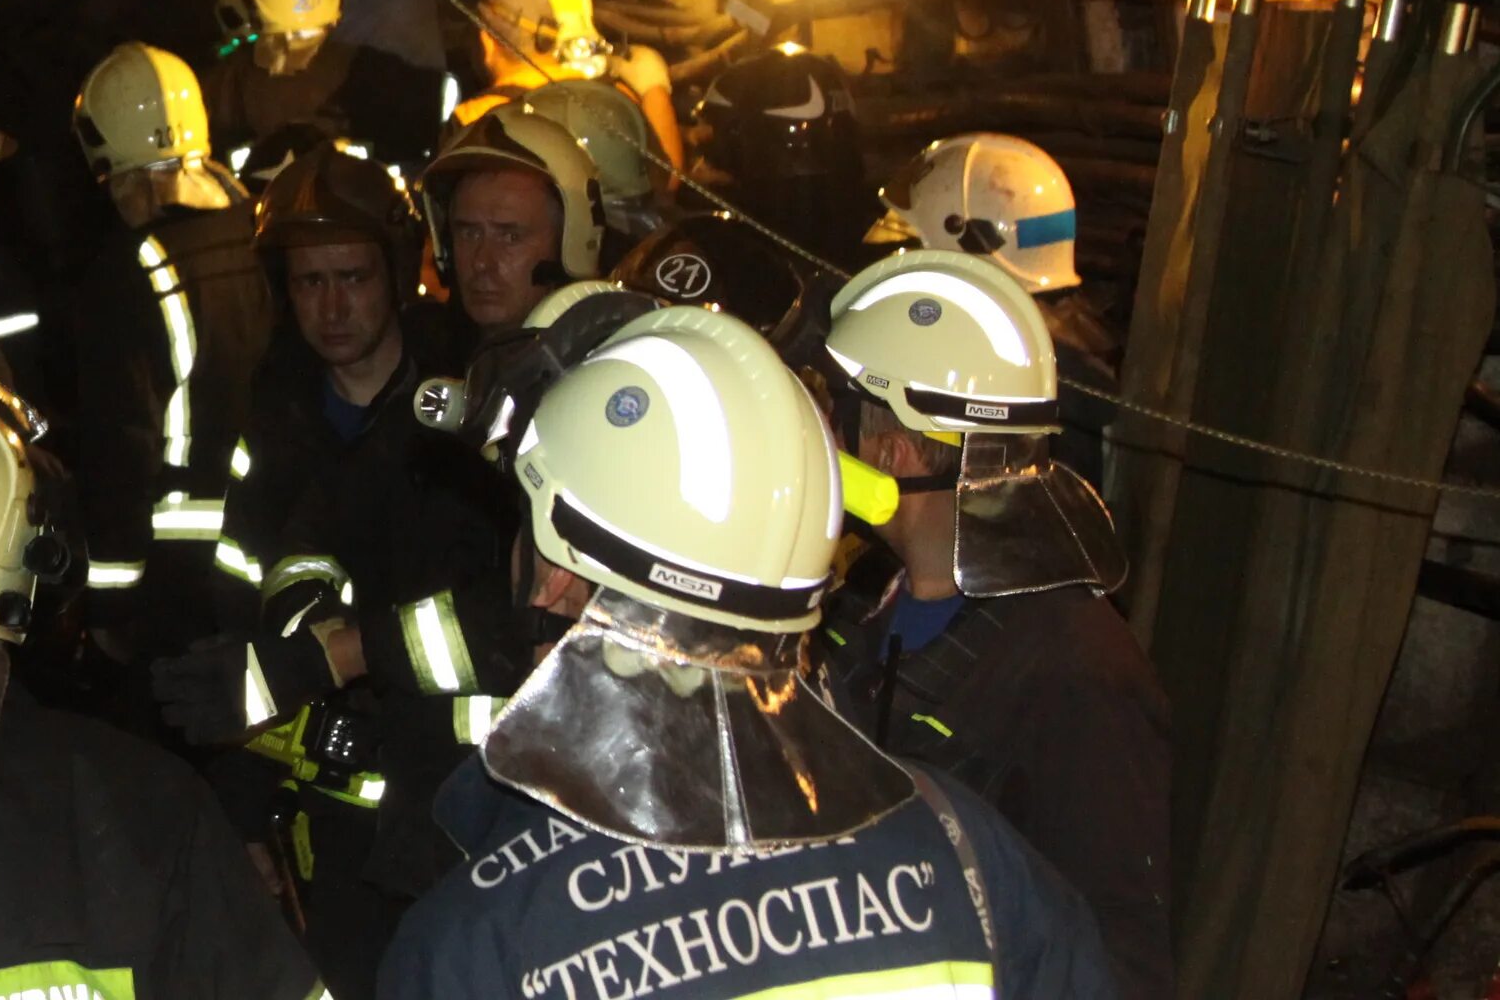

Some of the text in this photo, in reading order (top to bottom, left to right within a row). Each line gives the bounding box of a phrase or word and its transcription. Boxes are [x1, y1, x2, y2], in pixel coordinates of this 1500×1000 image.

[663, 258, 701, 290] 21
[967, 405, 1006, 417] MSA
[655, 569, 715, 596] MSA
